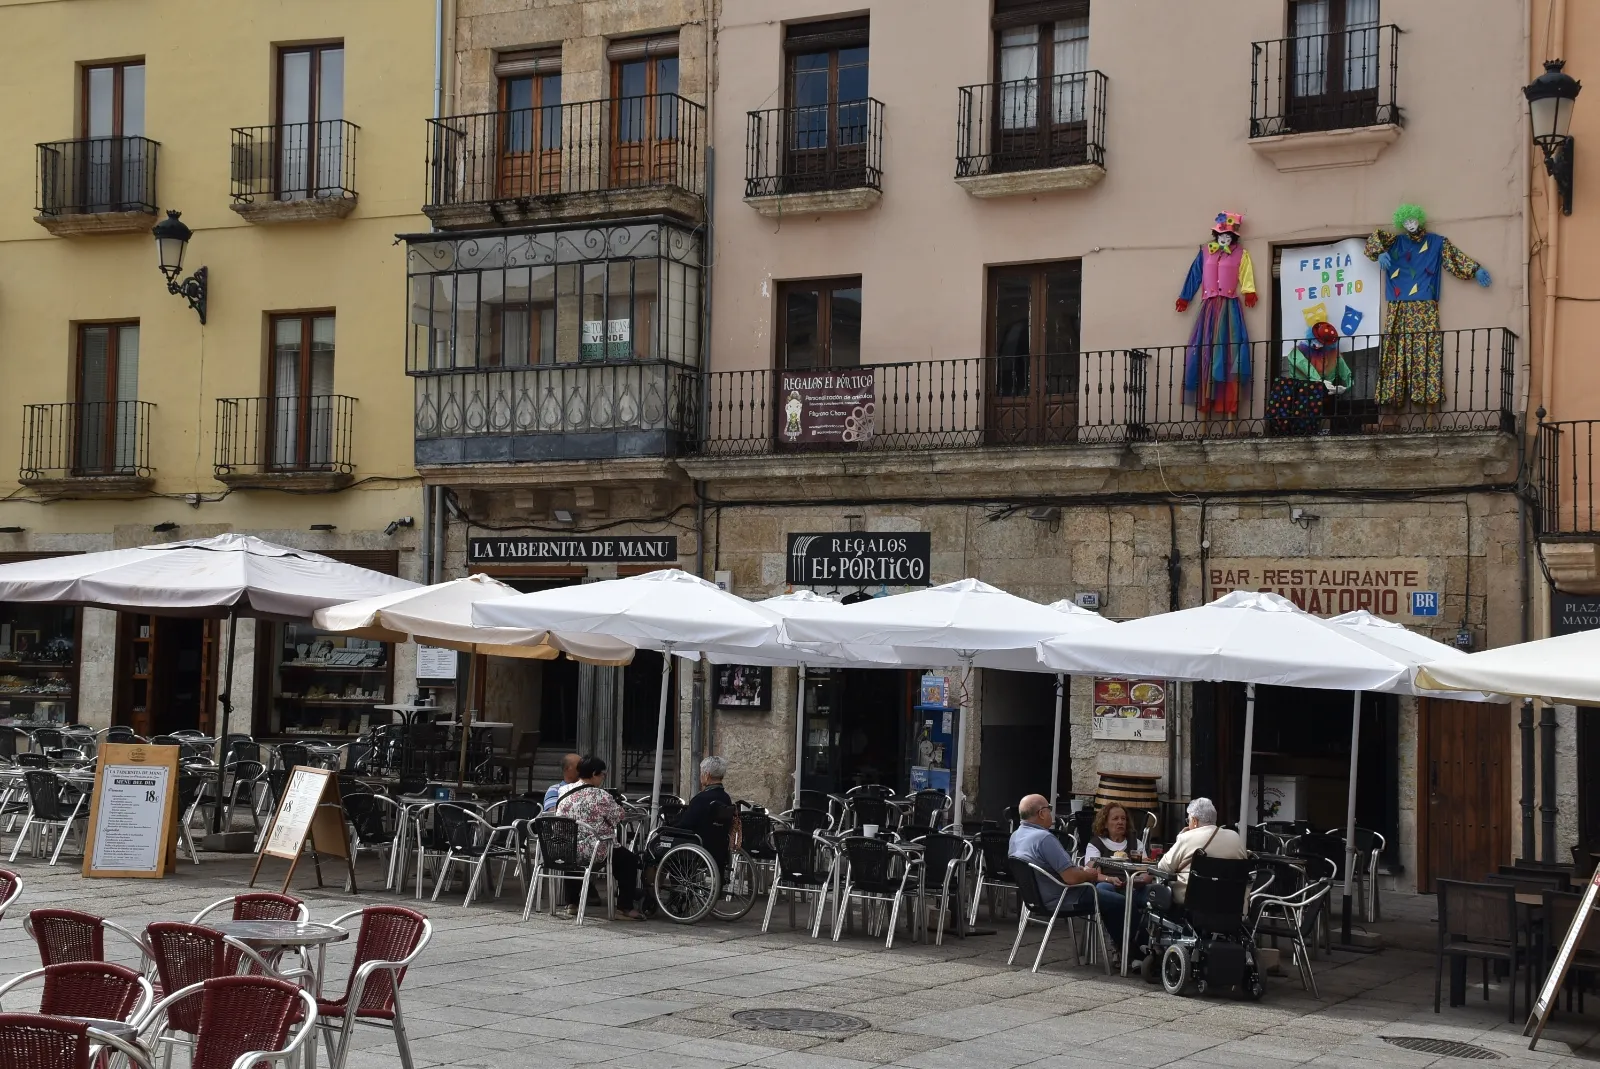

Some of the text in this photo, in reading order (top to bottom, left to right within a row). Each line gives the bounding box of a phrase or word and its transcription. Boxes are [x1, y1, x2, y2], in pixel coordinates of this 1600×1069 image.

[1321, 269, 1345, 283] DE
[1294, 280, 1364, 300] TEATRO
[784, 373, 873, 390] REGALOS EL PÓRTICO
[473, 541, 670, 558] LA TABERNITA DE MANU
[832, 538, 907, 553] REGALOS
[1415, 593, 1435, 607] BR
[1562, 616, 1600, 625] MAYO
